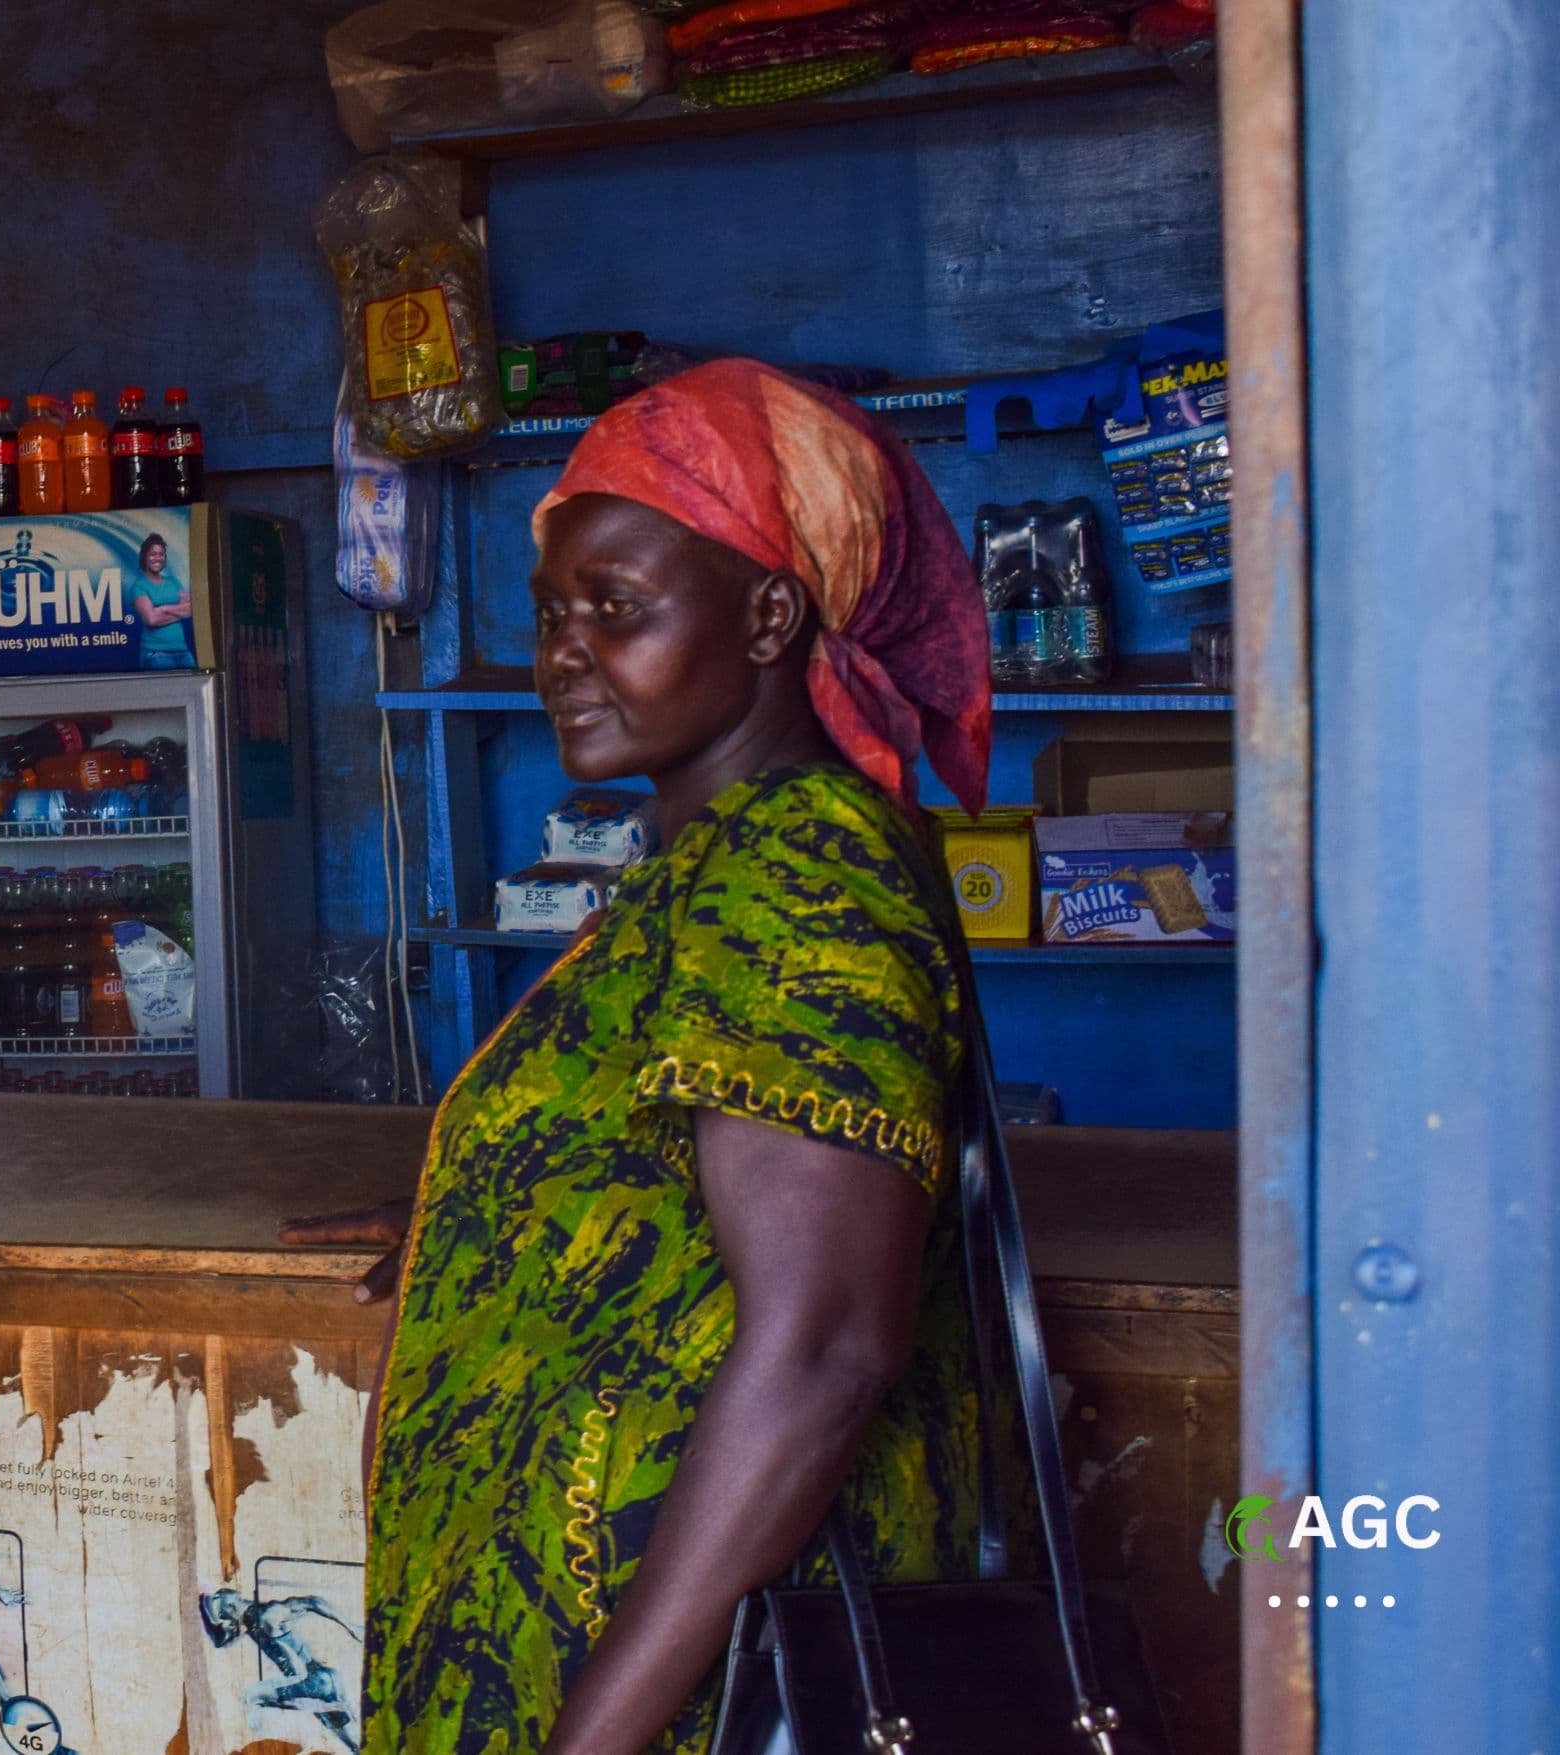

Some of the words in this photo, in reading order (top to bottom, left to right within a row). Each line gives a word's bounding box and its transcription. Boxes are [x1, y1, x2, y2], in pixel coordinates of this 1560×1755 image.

[26, 637, 48, 652] you
[50, 633, 78, 648] with
[81, 636, 90, 646] a
[92, 631, 128, 646] smile
[525, 890, 553, 901] EXE
[966, 881, 991, 897] 20
[1063, 883, 1127, 918] Milk
[1064, 907, 1138, 936] Biscuits
[101, 1472, 119, 1482] on
[122, 1473, 161, 1489] Airtel
[17, 1480, 55, 1496] enjoy
[112, 1489, 155, 1504] better
[19, 1734, 44, 1752] 4G
